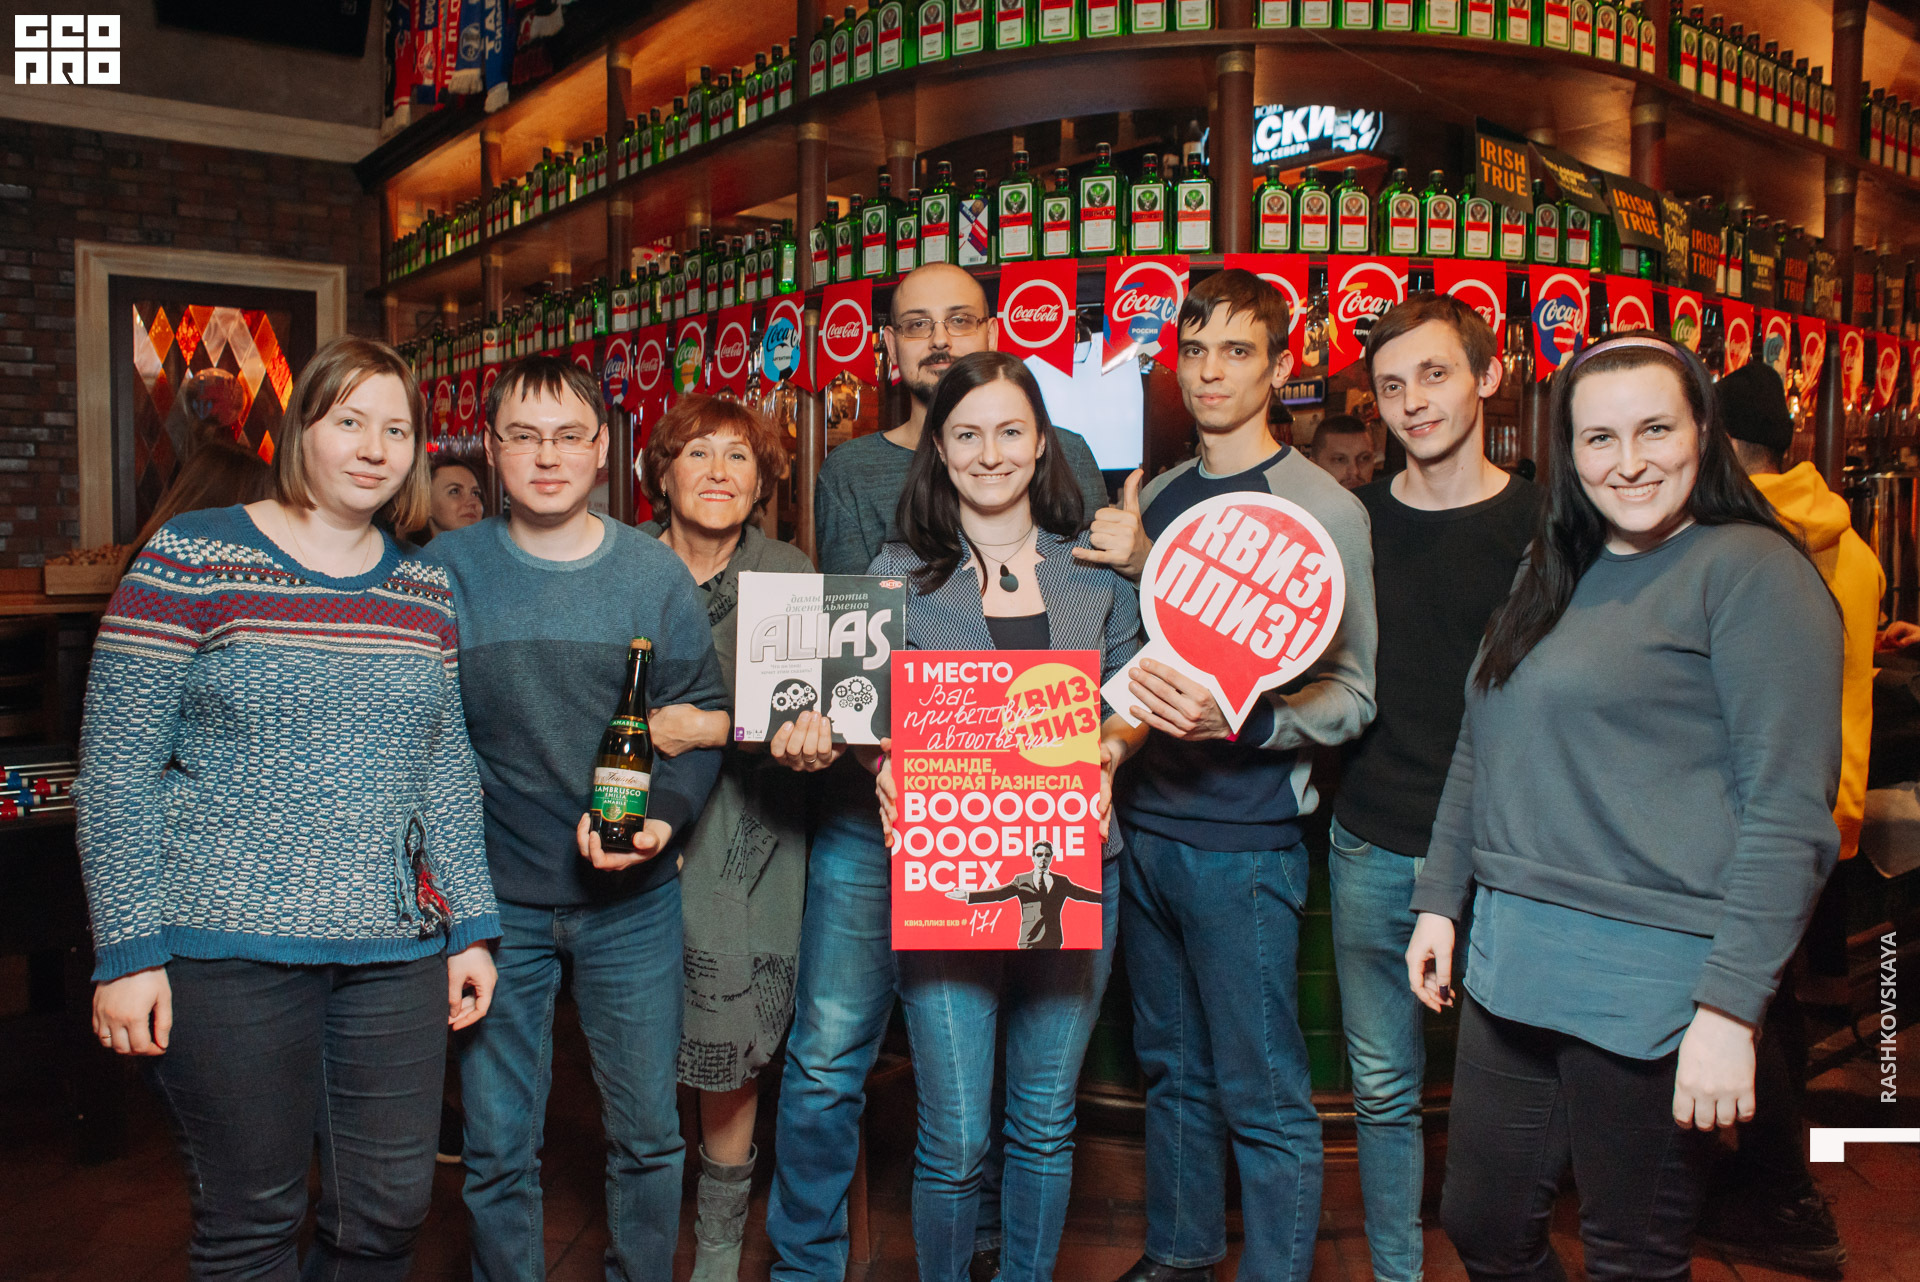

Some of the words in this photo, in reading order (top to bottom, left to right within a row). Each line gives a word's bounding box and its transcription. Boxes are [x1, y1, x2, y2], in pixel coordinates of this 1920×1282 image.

[1252, 105, 1336, 157] СКИ
[1271, 142, 1310, 161] СЕВЕРА
[1480, 137, 1526, 174] IRISH
[1481, 161, 1528, 197] TRUE
[1613, 189, 1656, 218] IRISH
[1618, 210, 1662, 239] TRUE
[1692, 229, 1720, 258] IRISH
[1010, 304, 1061, 323] Coca-Cola
[827, 321, 861, 339] Coca-Cola
[720, 341, 743, 358] Coca-Cola
[1188, 507, 1331, 619] КВИЗ,
[785, 602, 869, 613] джентльменов
[791, 594, 821, 604] дамы
[825, 593, 869, 604] против
[1154, 547, 1318, 669] ПЛИЗ!
[750, 609, 892, 670] ALIAS
[904, 662, 914, 683] 1
[923, 662, 1013, 683] МЕСТО
[919, 684, 977, 706] Вас
[612, 720, 639, 728] AMABILE
[904, 700, 1050, 735] приветствует
[904, 758, 997, 775] КОМАНДЕ,
[594, 785, 641, 797] LAMBRUSCO
[904, 775, 985, 790] КОТОРАЯ
[991, 775, 1083, 790] РАЗНЕСЛА
[904, 860, 1004, 892] ВСЕХ
[946, 919, 960, 927] ЕКВ
[969, 908, 1002, 936] 171
